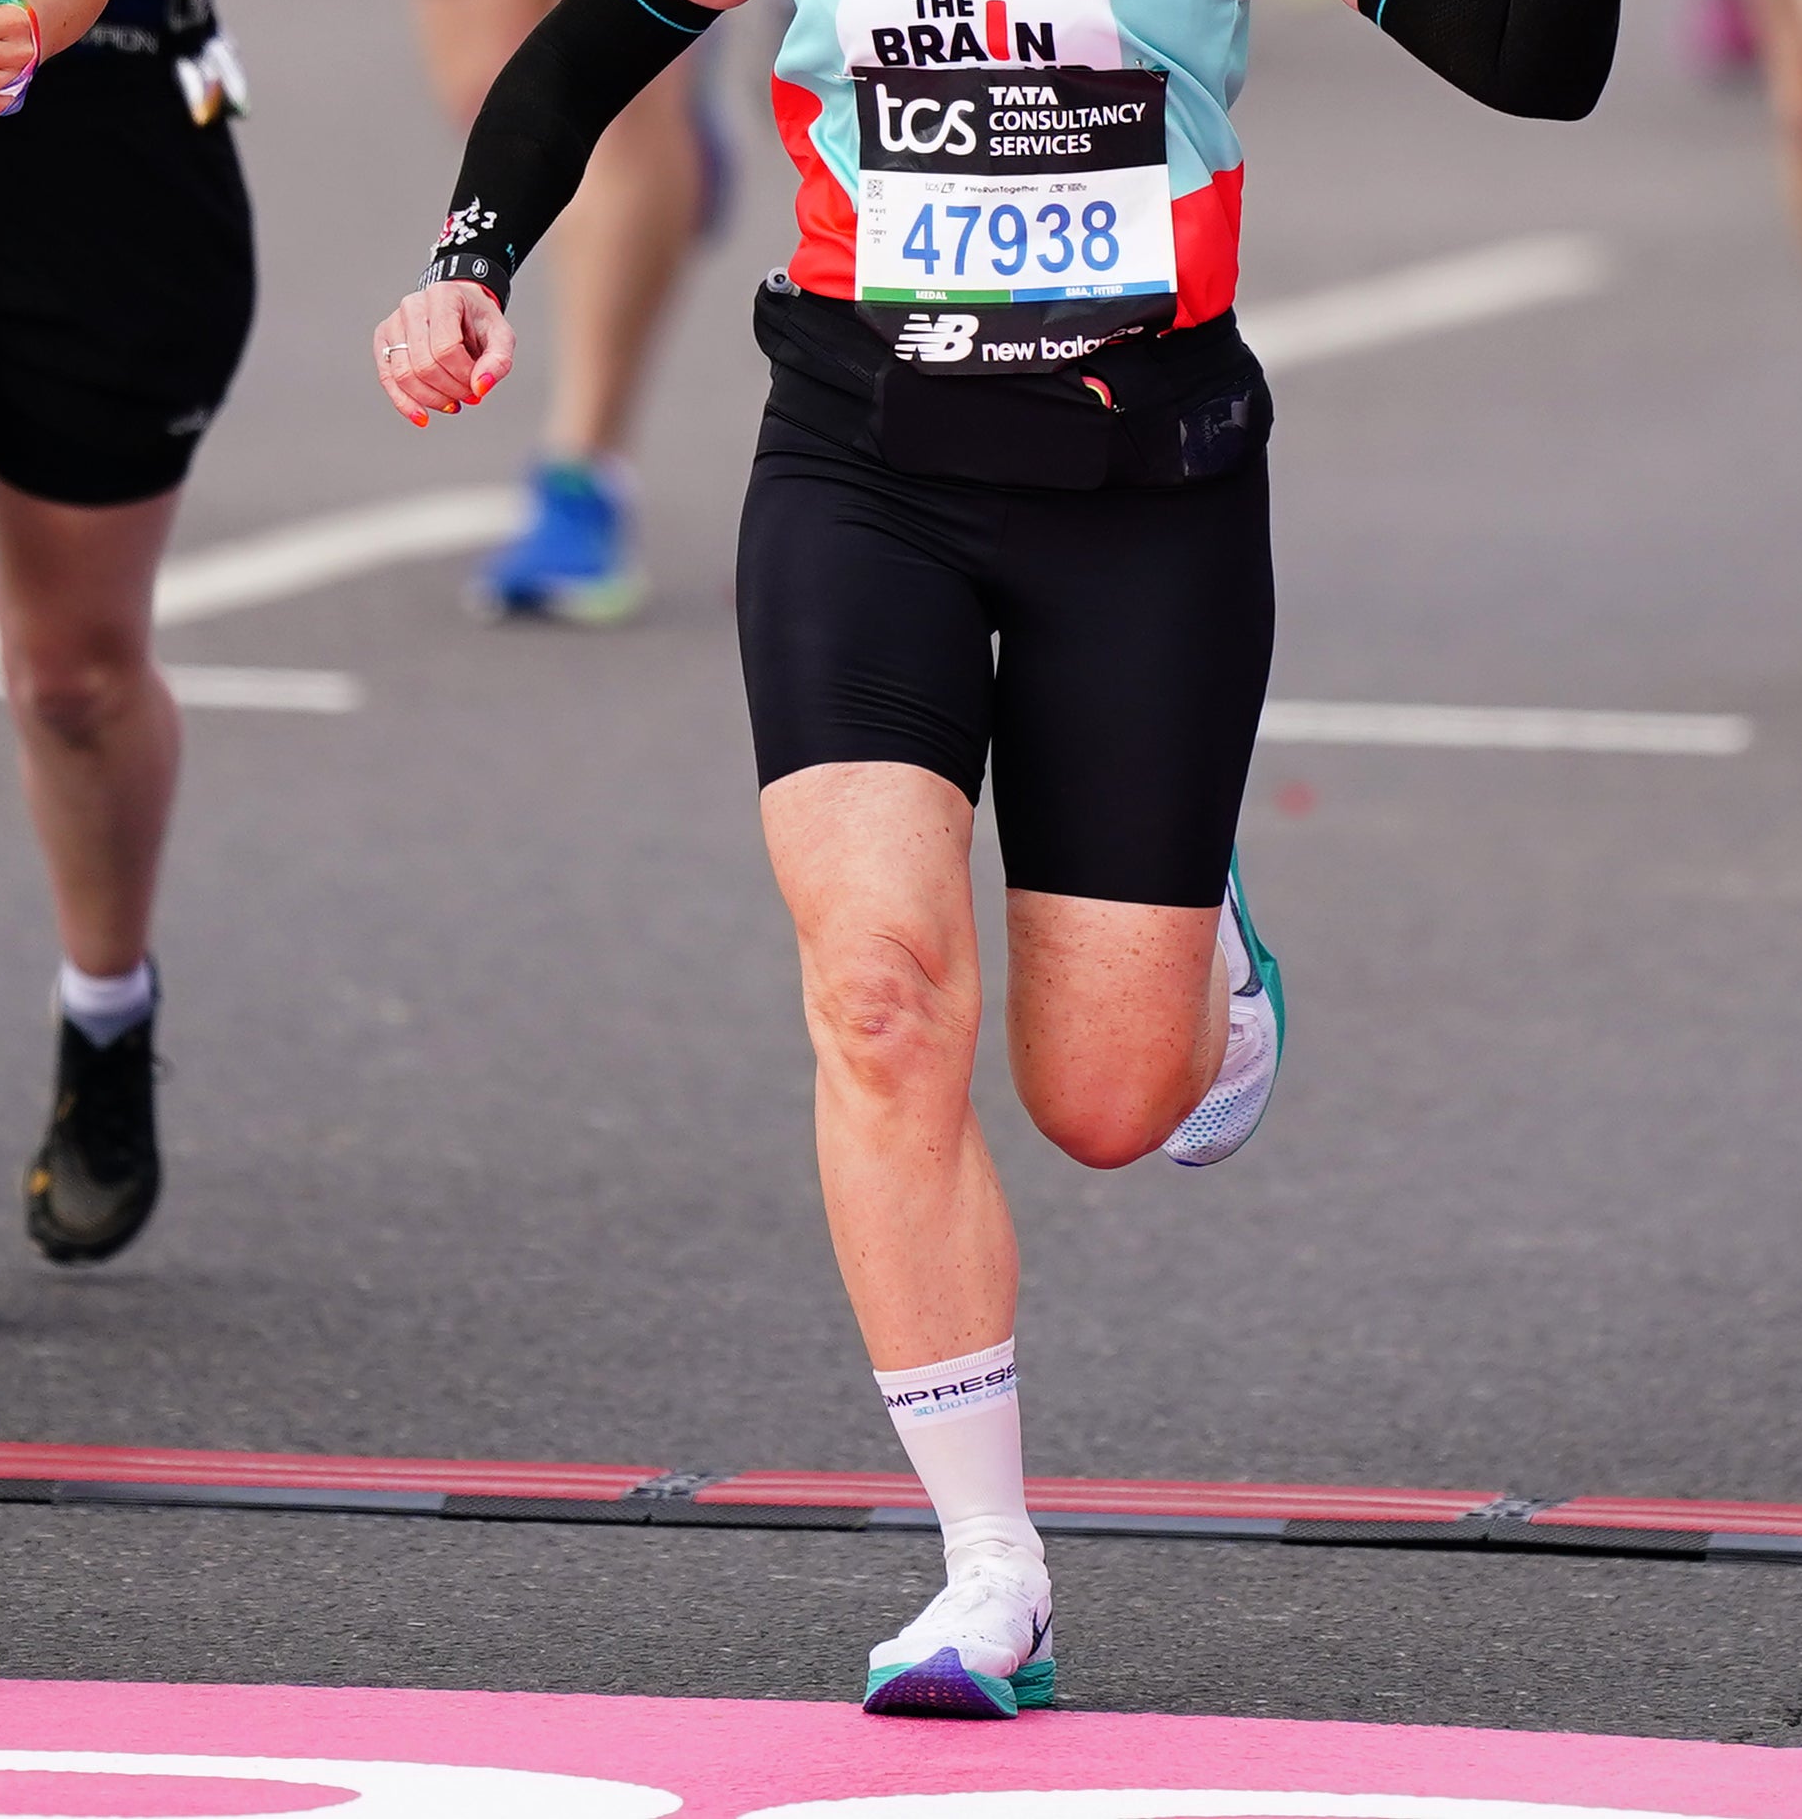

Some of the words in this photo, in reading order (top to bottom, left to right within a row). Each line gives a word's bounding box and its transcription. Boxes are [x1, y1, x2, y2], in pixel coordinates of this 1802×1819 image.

[871, 0, 1057, 67] BRAIN
[988, 85, 1059, 106] TATA
[875, 83, 977, 156] tcs
[988, 101, 1147, 133] CONSULTANCY
[989, 132, 1092, 157] SERVICES
[902, 200, 1120, 277] 47938
[915, 290, 947, 300] MEDAL
[1093, 285, 1123, 295] FITTED
[981, 341, 1036, 362] new
